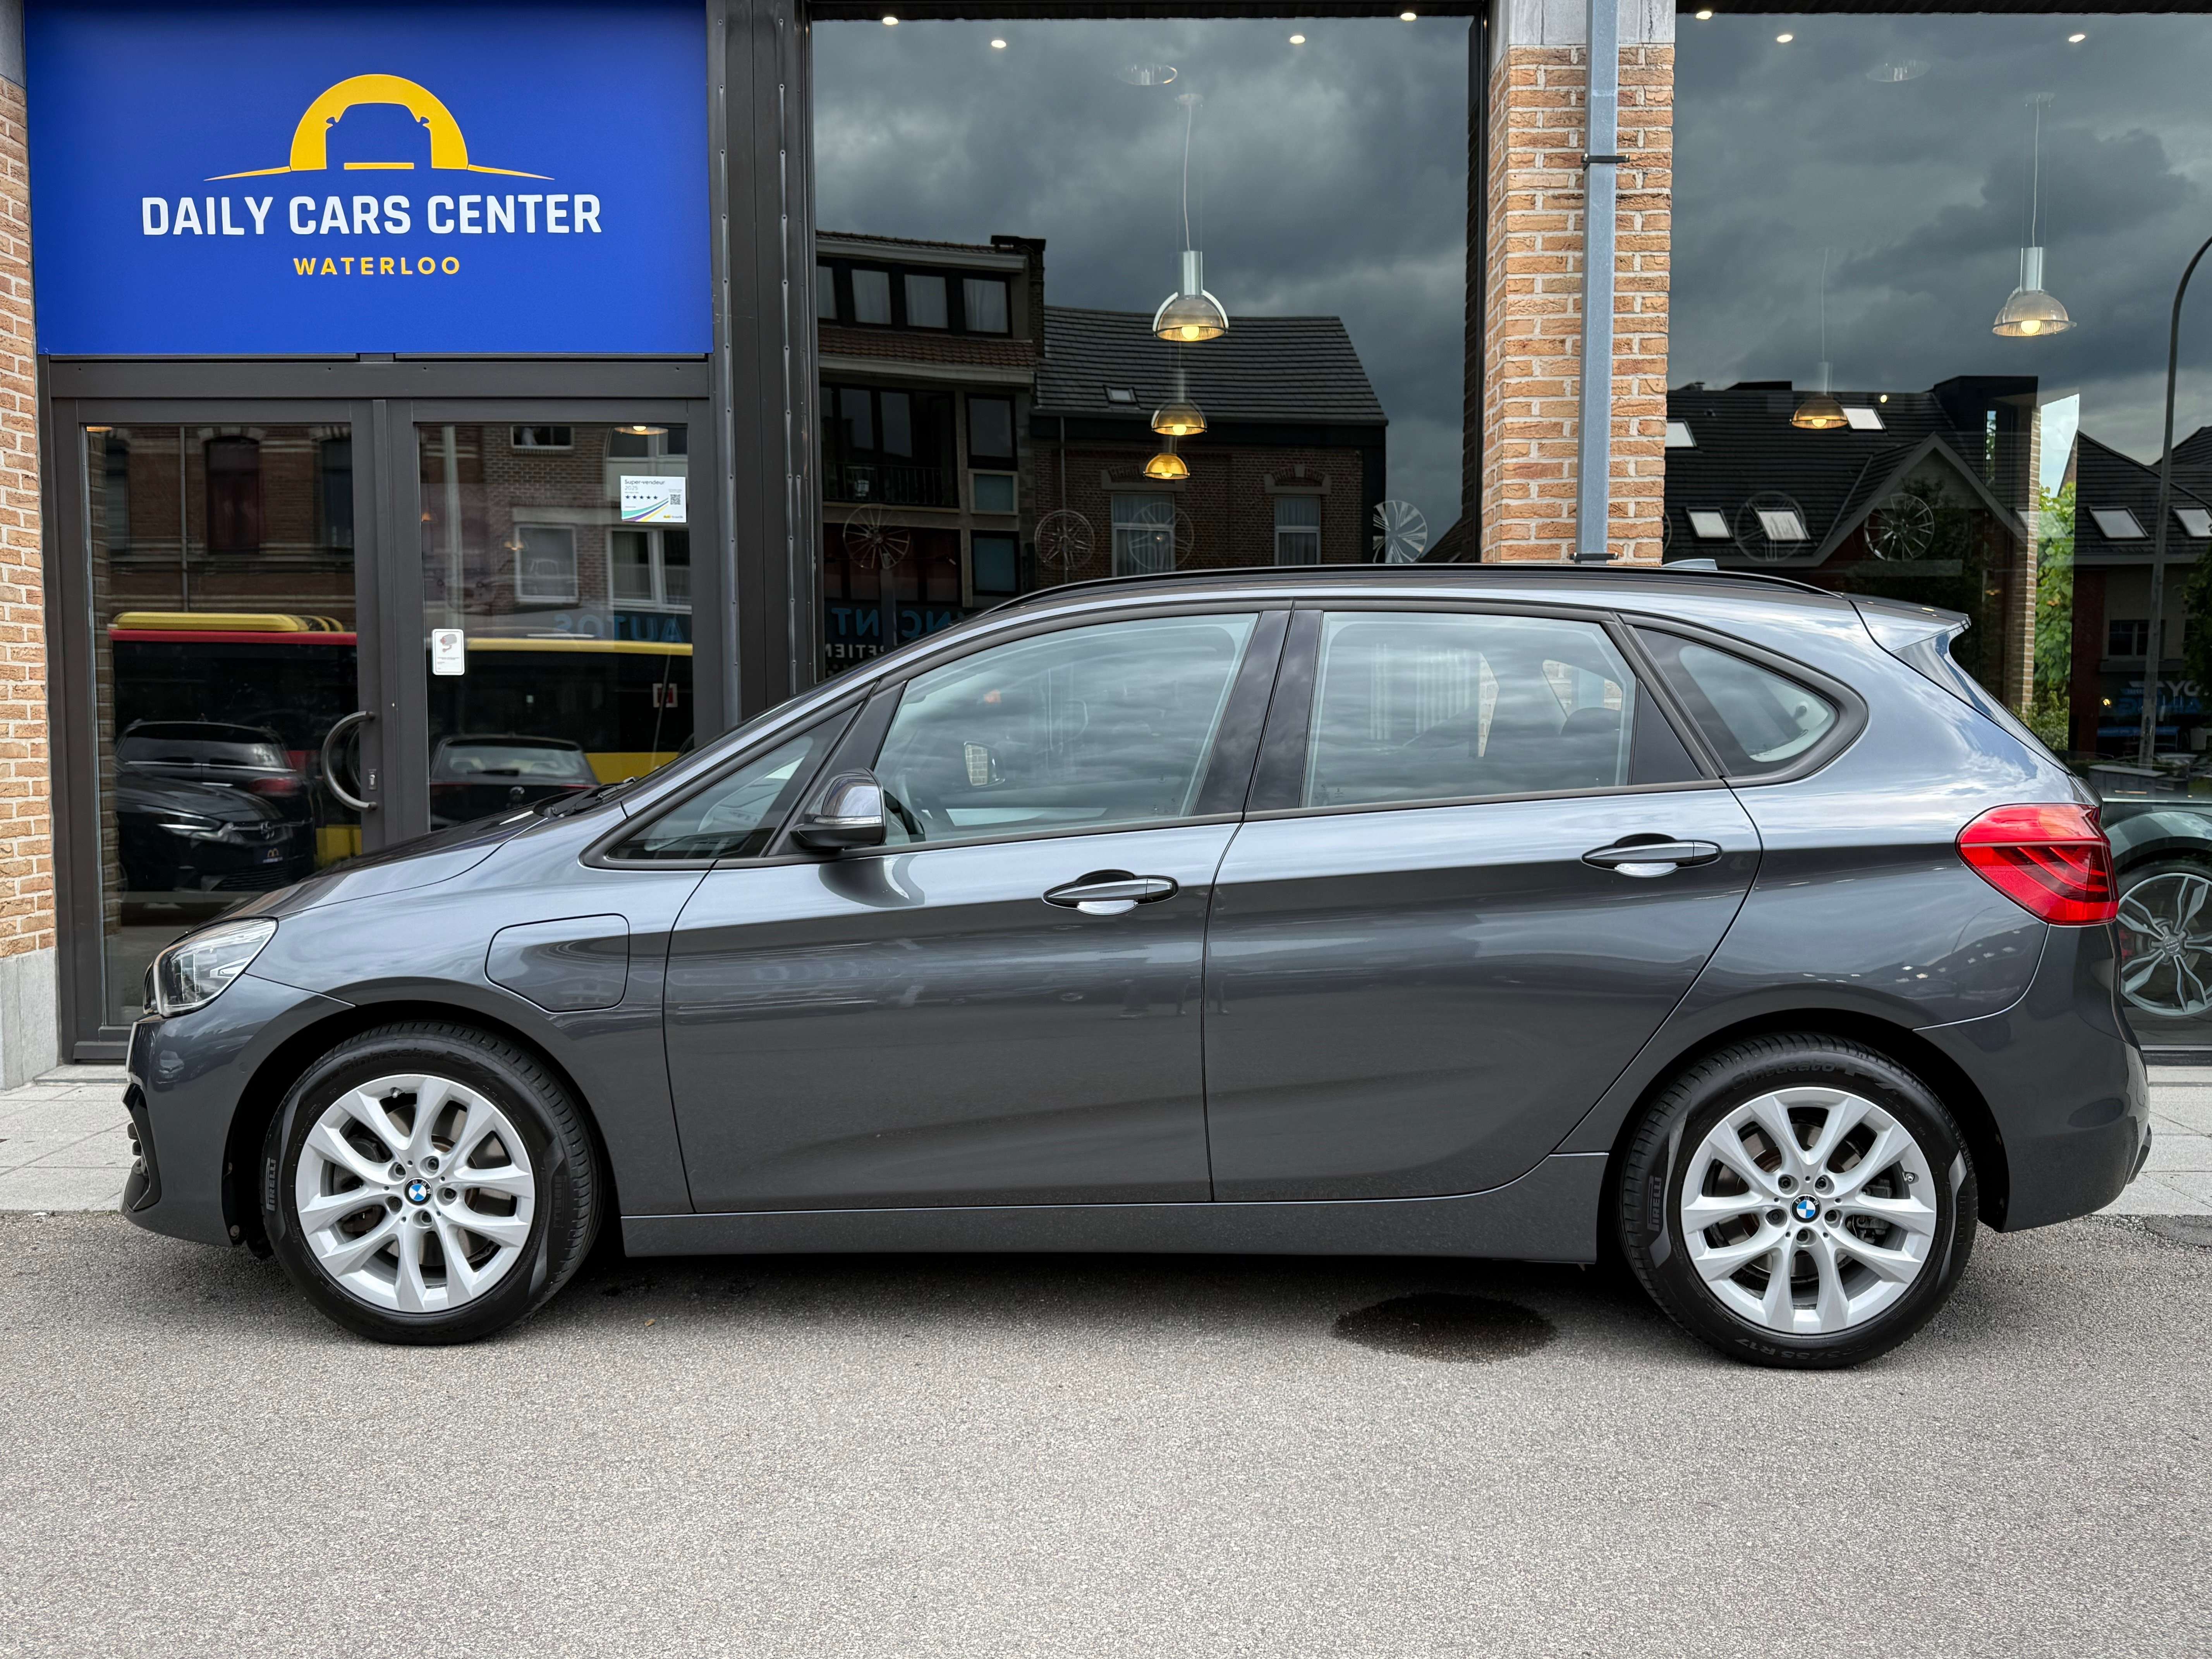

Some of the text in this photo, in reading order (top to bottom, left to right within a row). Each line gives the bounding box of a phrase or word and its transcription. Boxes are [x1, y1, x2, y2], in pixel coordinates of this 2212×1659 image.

[143, 194, 601, 235] DAILY CARS CENTER
[294, 257, 459, 275] WATERLOO
[265, 1157, 276, 1211] PIRELLI
[1647, 1175, 1662, 1232] PIRELLI
